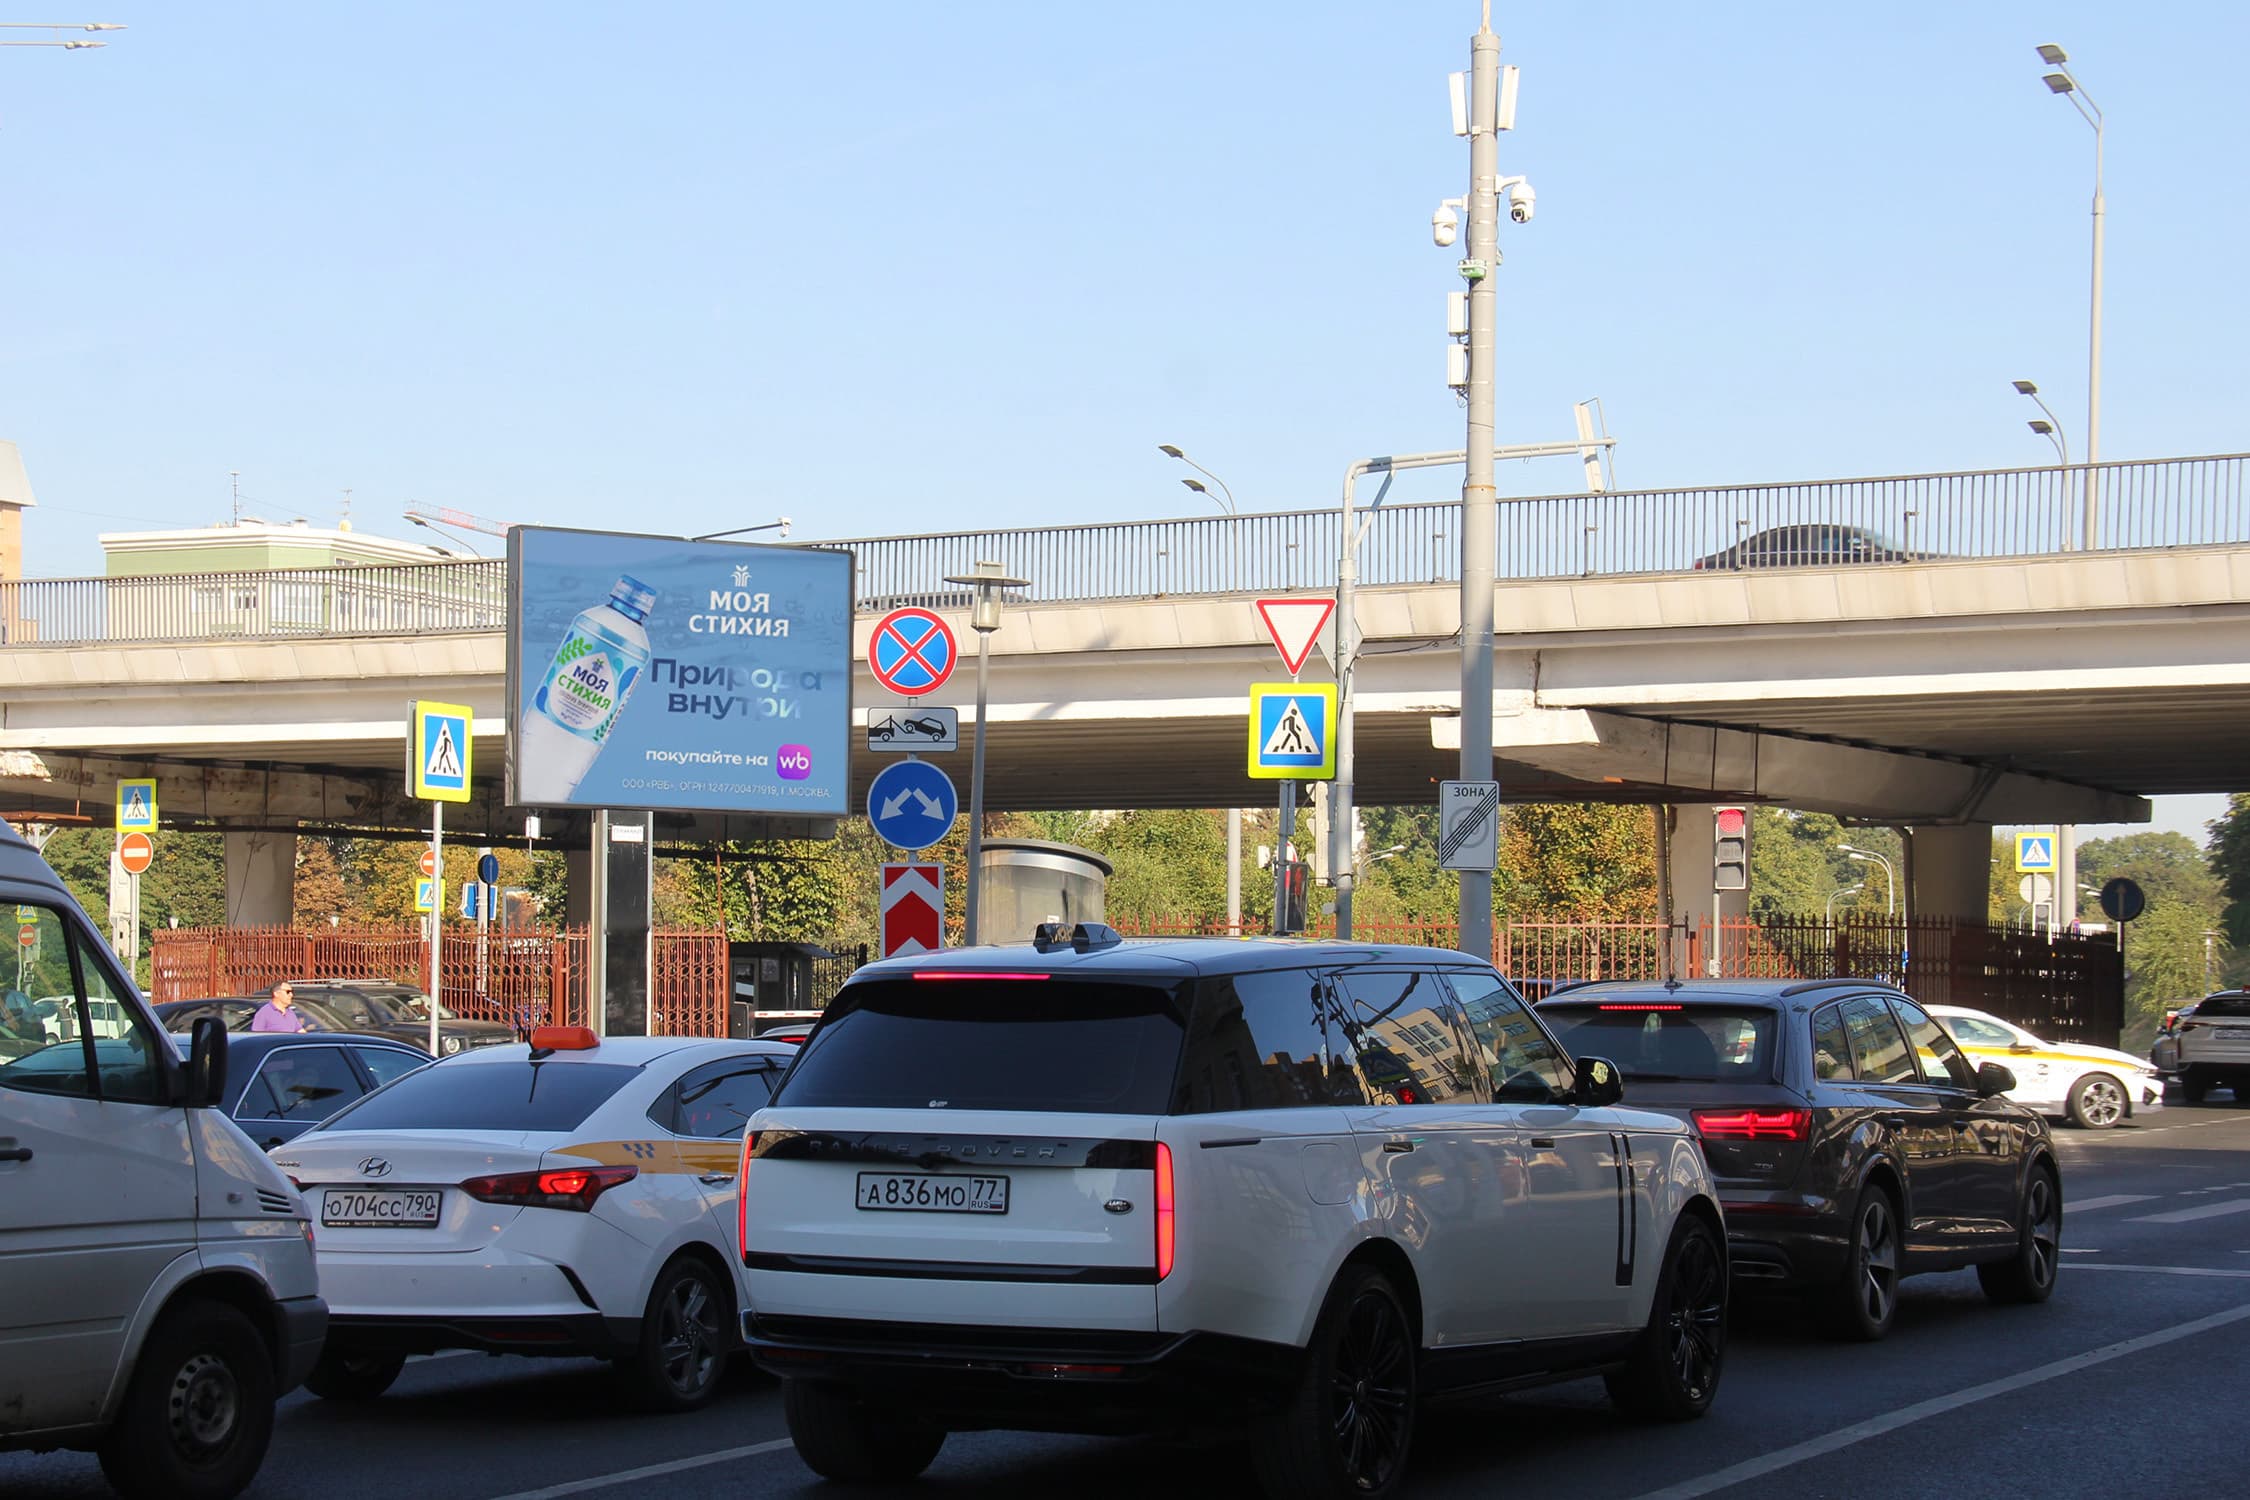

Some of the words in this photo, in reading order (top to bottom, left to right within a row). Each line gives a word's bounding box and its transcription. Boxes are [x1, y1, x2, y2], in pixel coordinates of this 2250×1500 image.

[709, 591, 770, 613] МОЯ
[689, 614, 789, 637] СТИХИЯ
[572, 665, 609, 692] МОЯ
[651, 657, 822, 693] Природа
[558, 674, 612, 710] СТИХИЯ
[668, 693, 800, 720] внутри
[645, 750, 742, 765] покупайте
[746, 755, 769, 766] на
[780, 751, 809, 770] wb
[622, 778, 645, 789] ООО
[1453, 786, 1486, 797] ЗОНА
[937, 1144, 1057, 1159] ROVER
[406, 1194, 436, 1211] 790
[867, 1178, 966, 1206] А836МО
[973, 1179, 998, 1200] 77
[971, 1200, 989, 1209] RUS
